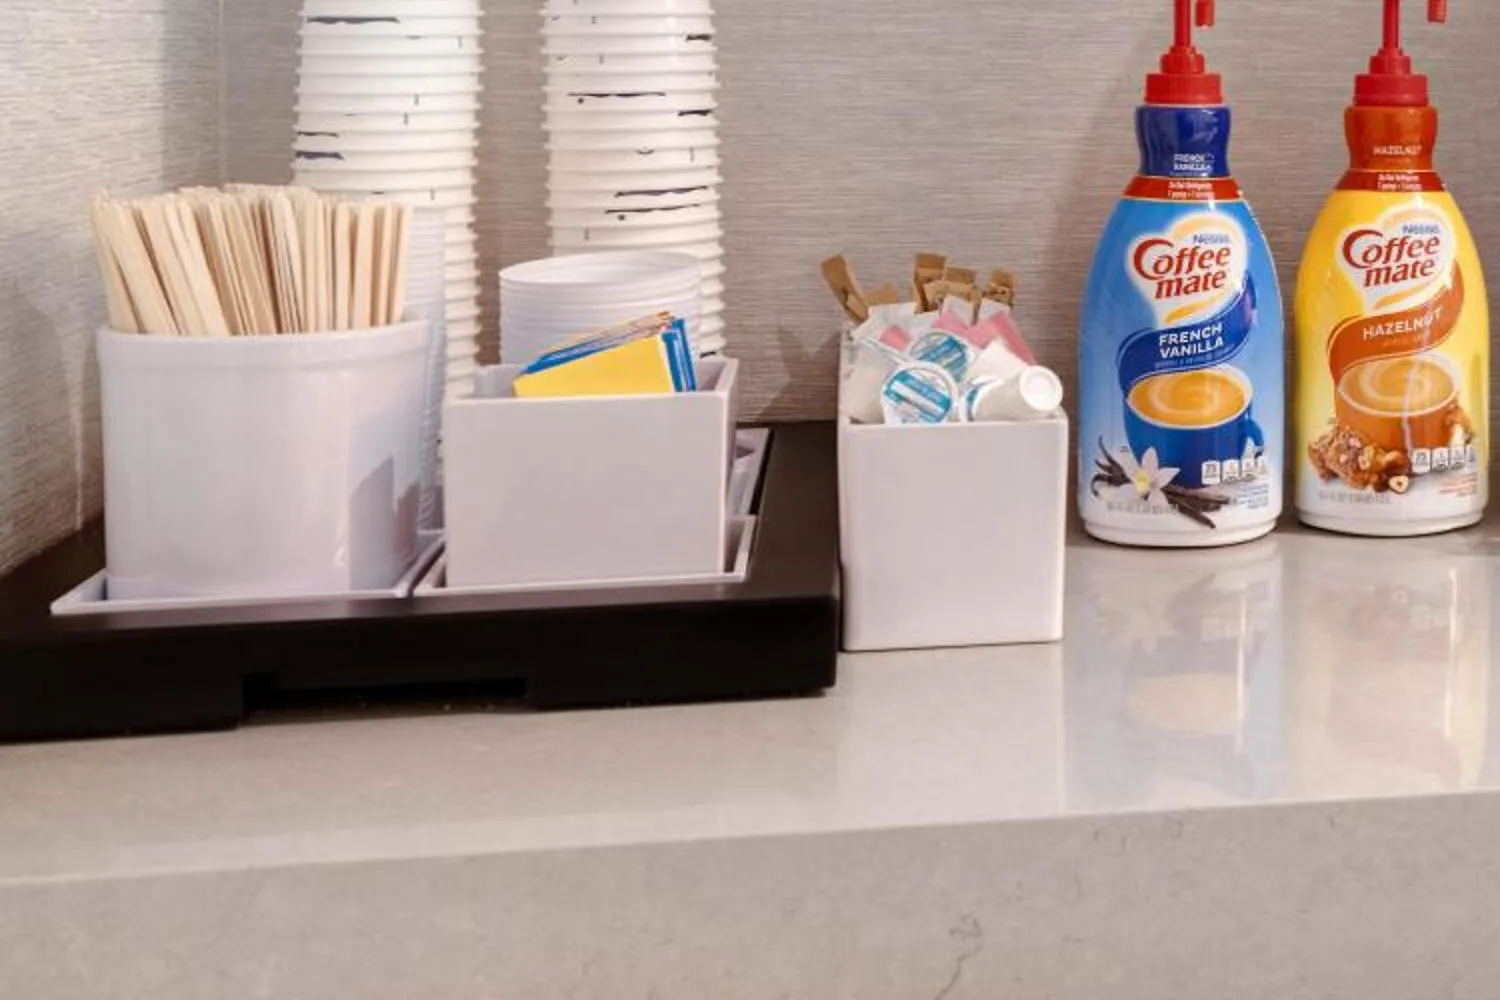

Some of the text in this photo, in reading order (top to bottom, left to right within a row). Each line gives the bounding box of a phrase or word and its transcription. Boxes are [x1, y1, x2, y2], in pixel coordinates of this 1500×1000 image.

[1133, 238, 1231, 281] Coffee
[1342, 229, 1441, 269] Coffee
[1154, 269, 1227, 299] mate
[1363, 258, 1436, 288] mate
[1159, 322, 1223, 346] FRENCH
[1363, 309, 1442, 340] HAZELNUT
[1160, 338, 1224, 359] VANILLA
